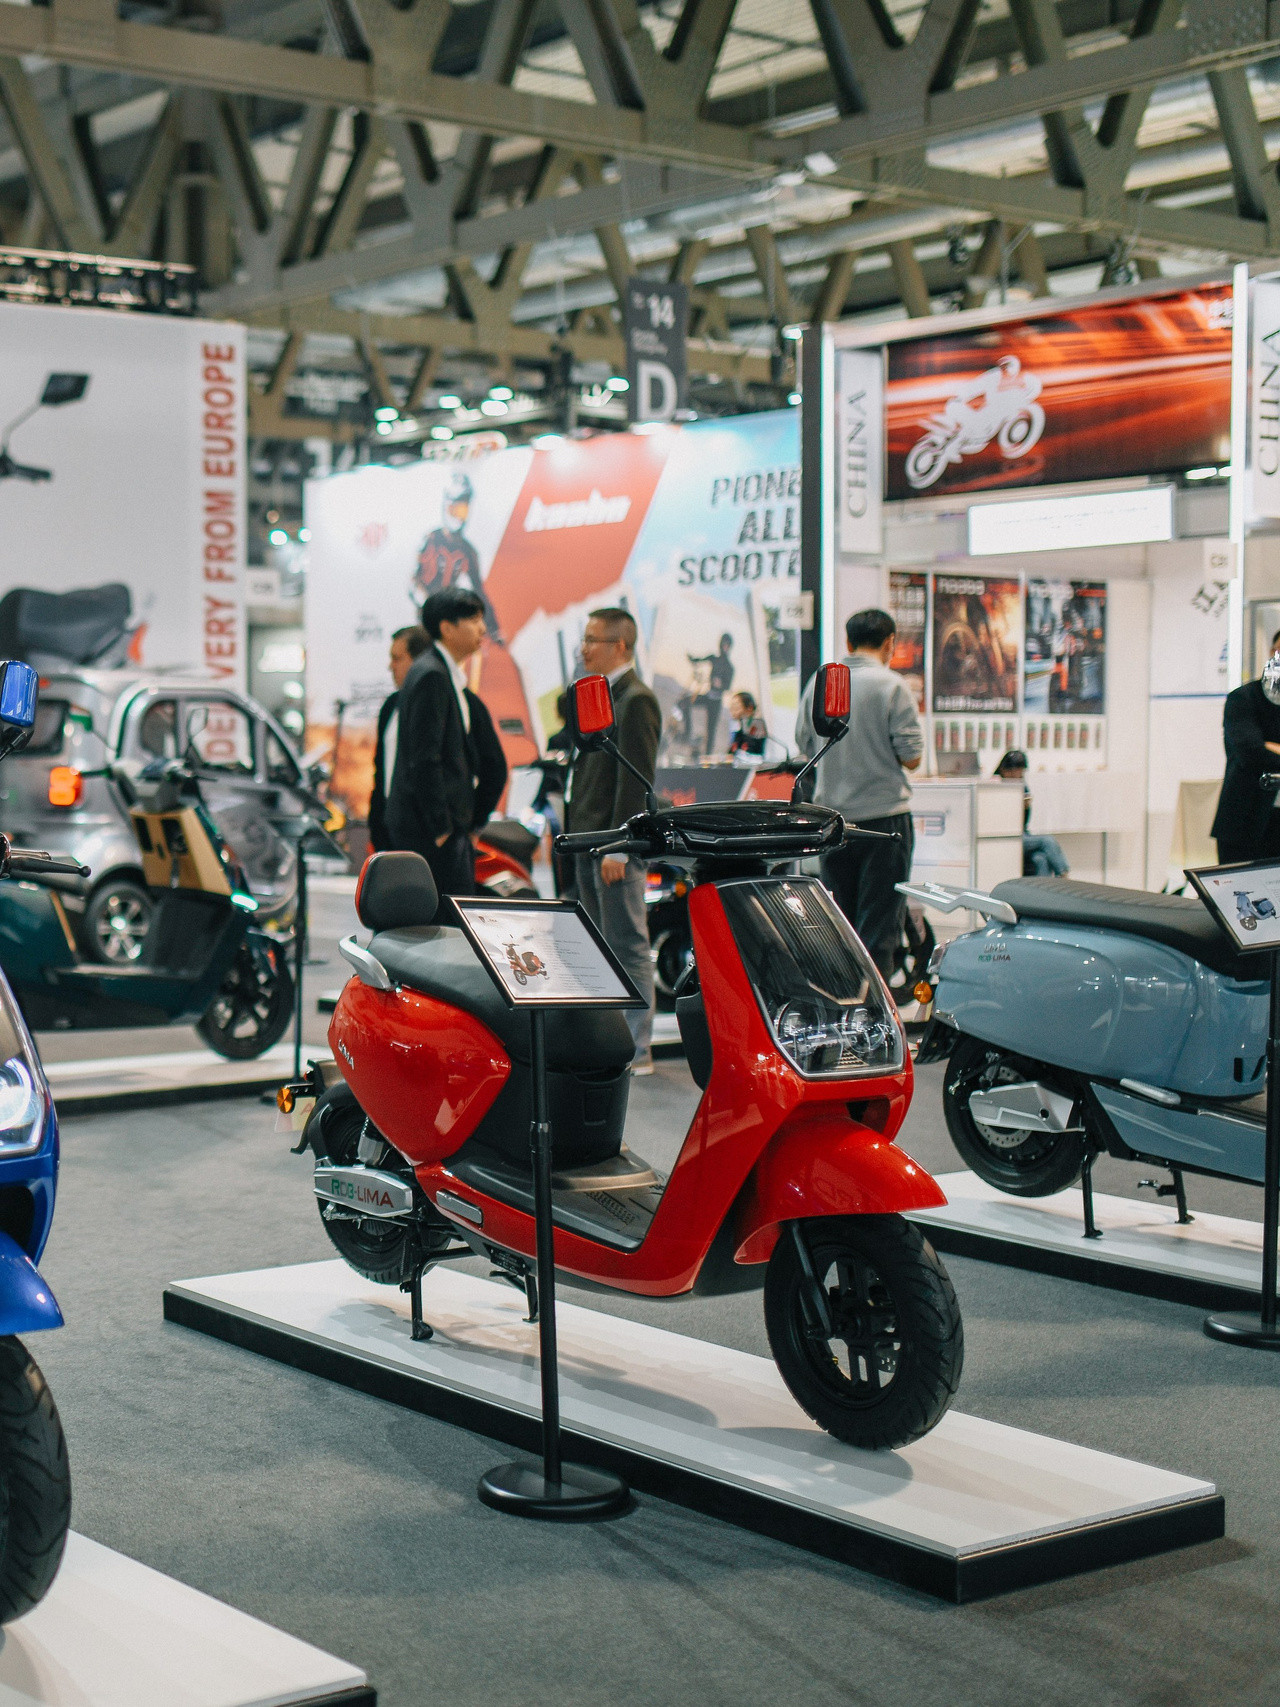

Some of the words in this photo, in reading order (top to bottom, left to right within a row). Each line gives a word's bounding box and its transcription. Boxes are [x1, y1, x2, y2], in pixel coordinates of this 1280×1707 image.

[203, 343, 236, 477] EUROPE
[636, 359, 678, 422] D
[847, 390, 867, 518] CHINA
[204, 491, 236, 582] FROM
[737, 507, 801, 544] ALL
[338, 1038, 355, 1070] LIMA
[331, 1178, 395, 1208] RDB-LIMA
